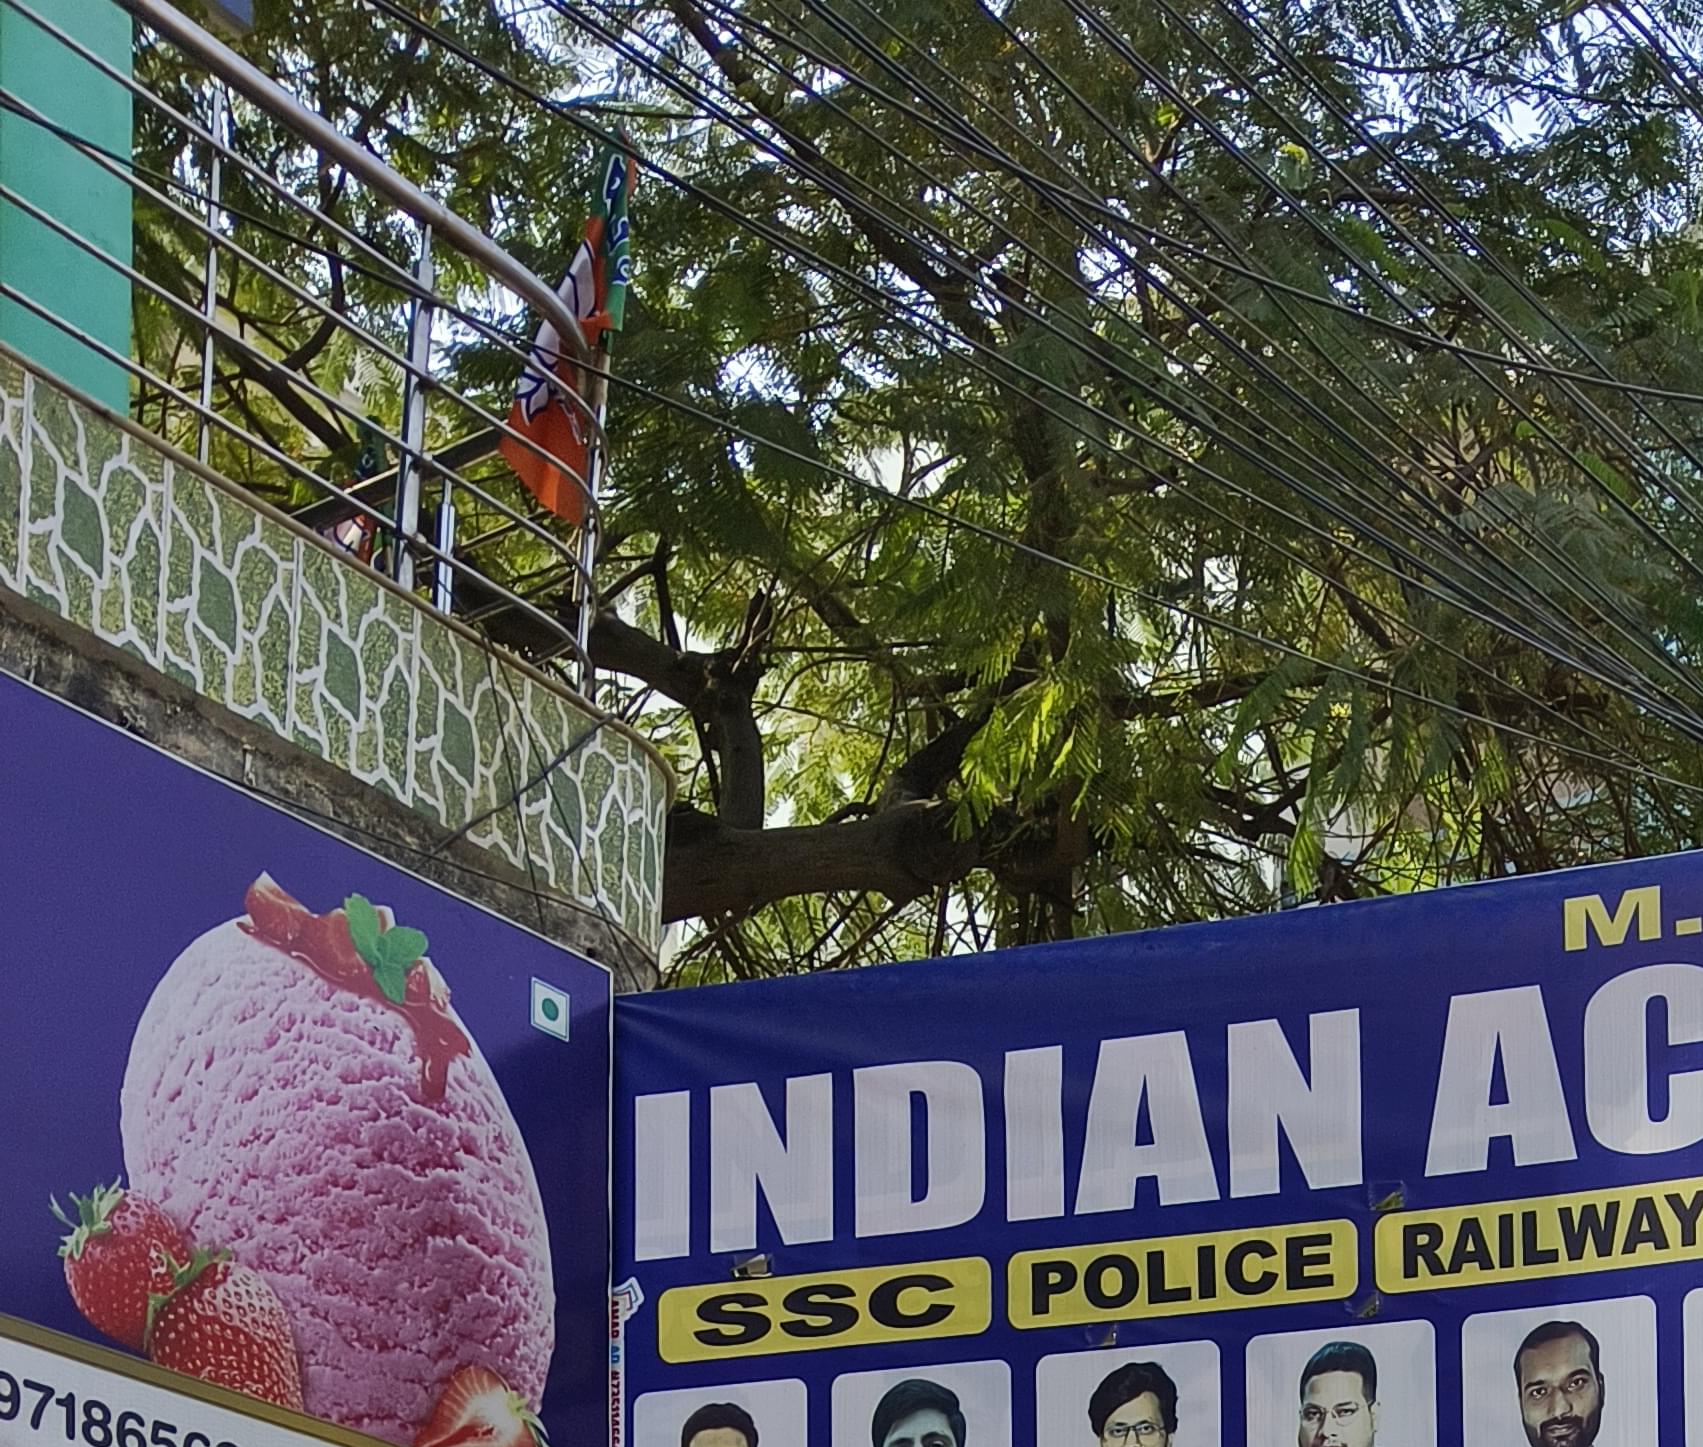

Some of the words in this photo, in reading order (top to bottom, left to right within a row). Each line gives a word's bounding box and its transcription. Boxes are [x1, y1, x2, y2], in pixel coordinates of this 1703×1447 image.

[1564, 885, 1702, 952] M.
[635, 1007, 1363, 1261] INDIAN
[692, 1273, 955, 1346] SSC
[1030, 1233, 1335, 1315] POLICE
